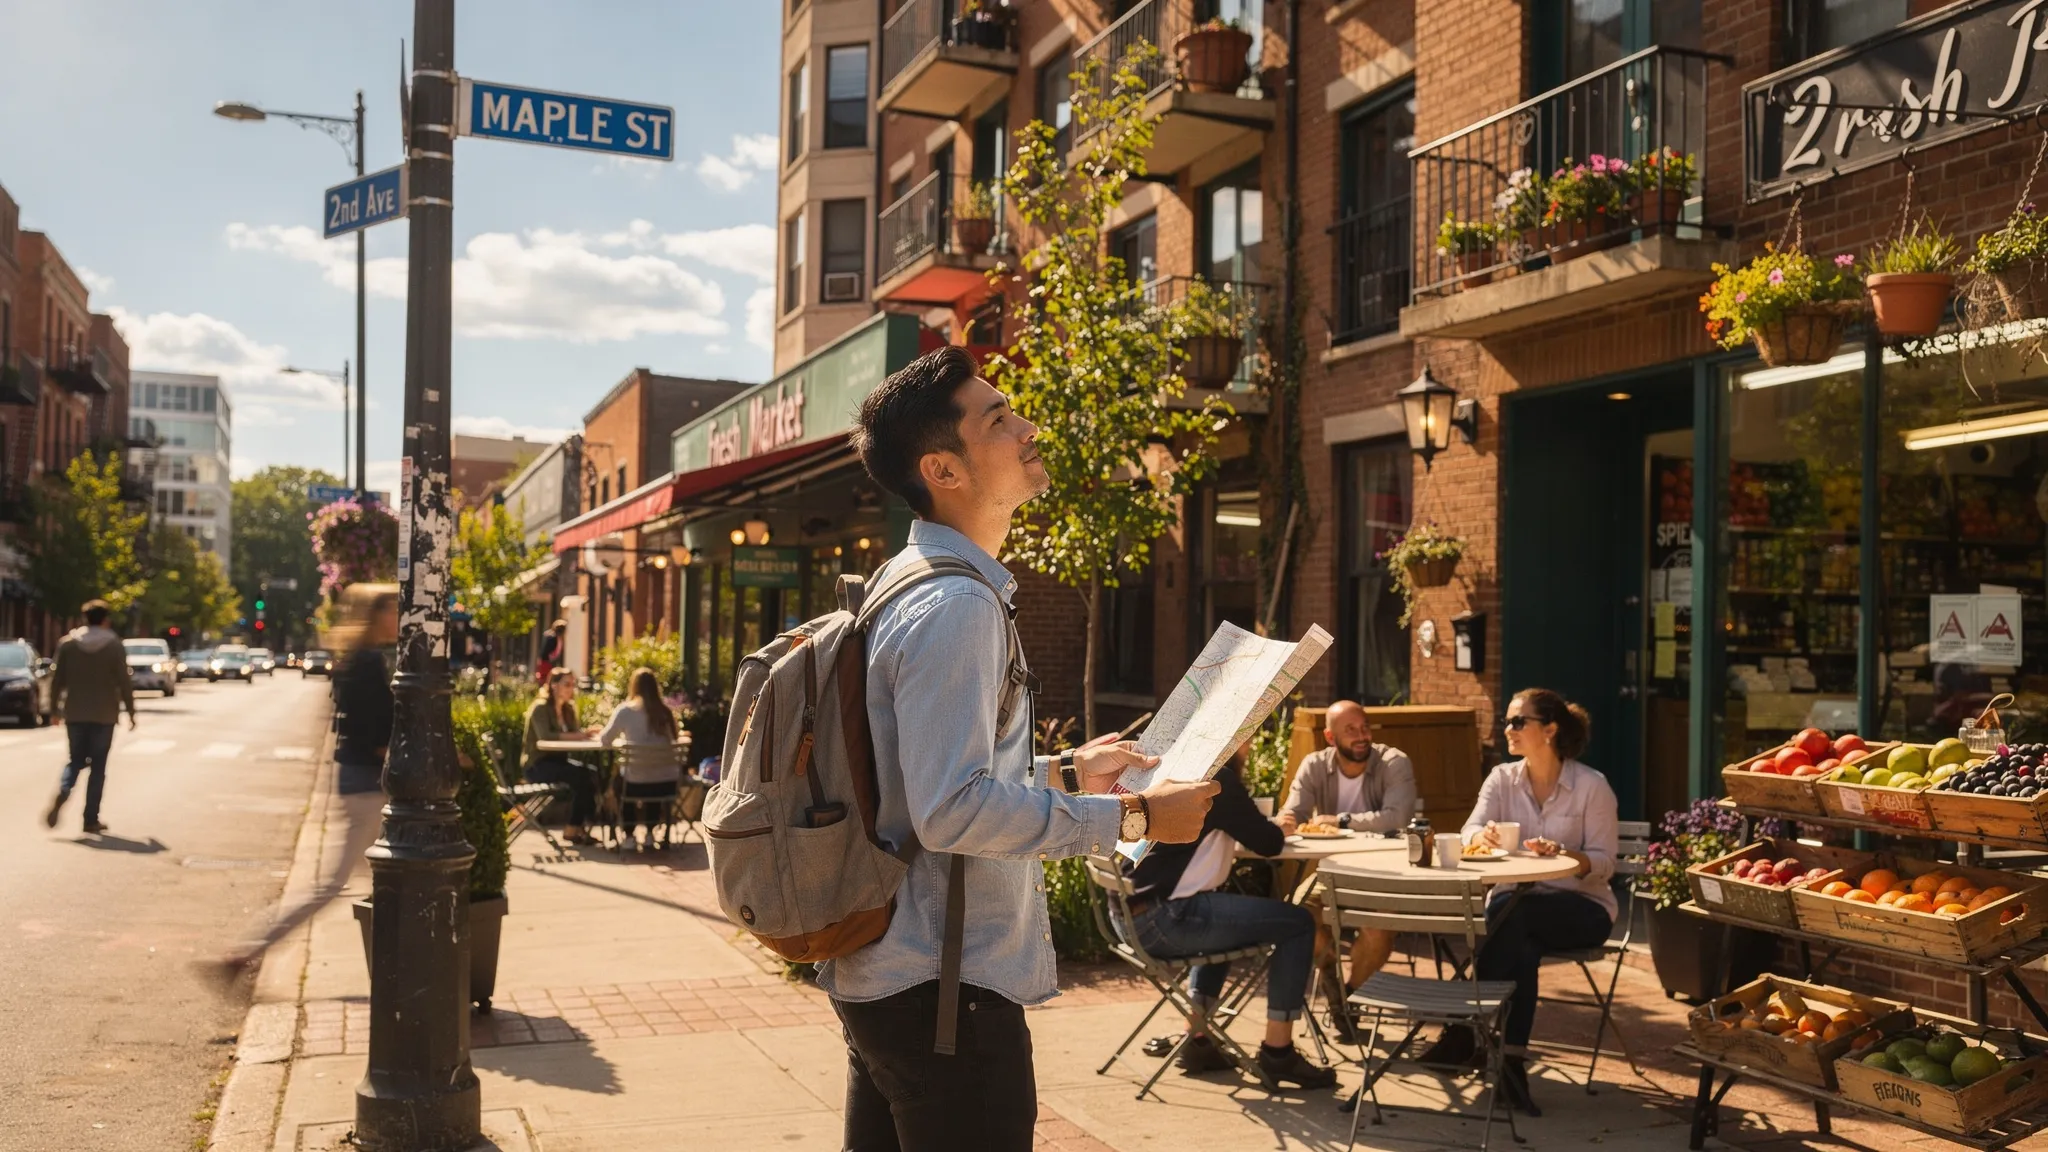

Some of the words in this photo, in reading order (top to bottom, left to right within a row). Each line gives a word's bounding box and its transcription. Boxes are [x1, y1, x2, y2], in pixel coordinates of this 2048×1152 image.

[481, 91, 613, 145] MAPLE
[625, 111, 668, 150] ST
[329, 188, 359, 229] 2nd
[747, 375, 804, 458] Market
